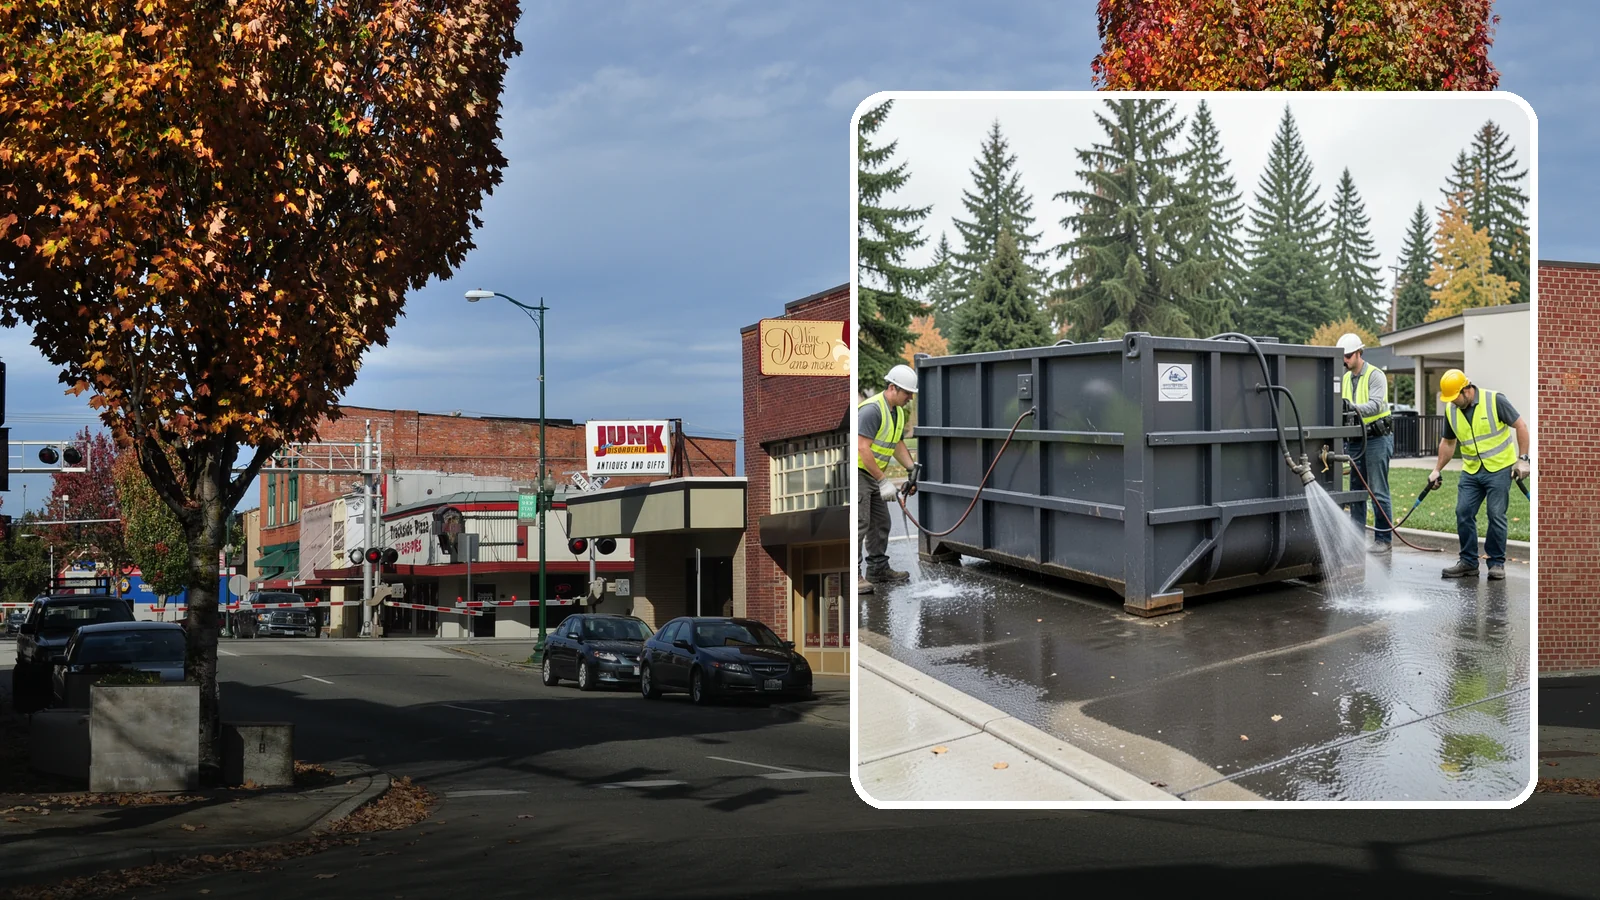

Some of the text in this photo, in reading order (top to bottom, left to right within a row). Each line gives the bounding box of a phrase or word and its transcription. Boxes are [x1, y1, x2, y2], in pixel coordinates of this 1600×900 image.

[595, 425, 666, 457] JUNK
[607, 446, 646, 454] DISORDERLY
[597, 460, 666, 470] ANTIQUES AND GIFTS
[414, 519, 429, 535] Pizza
